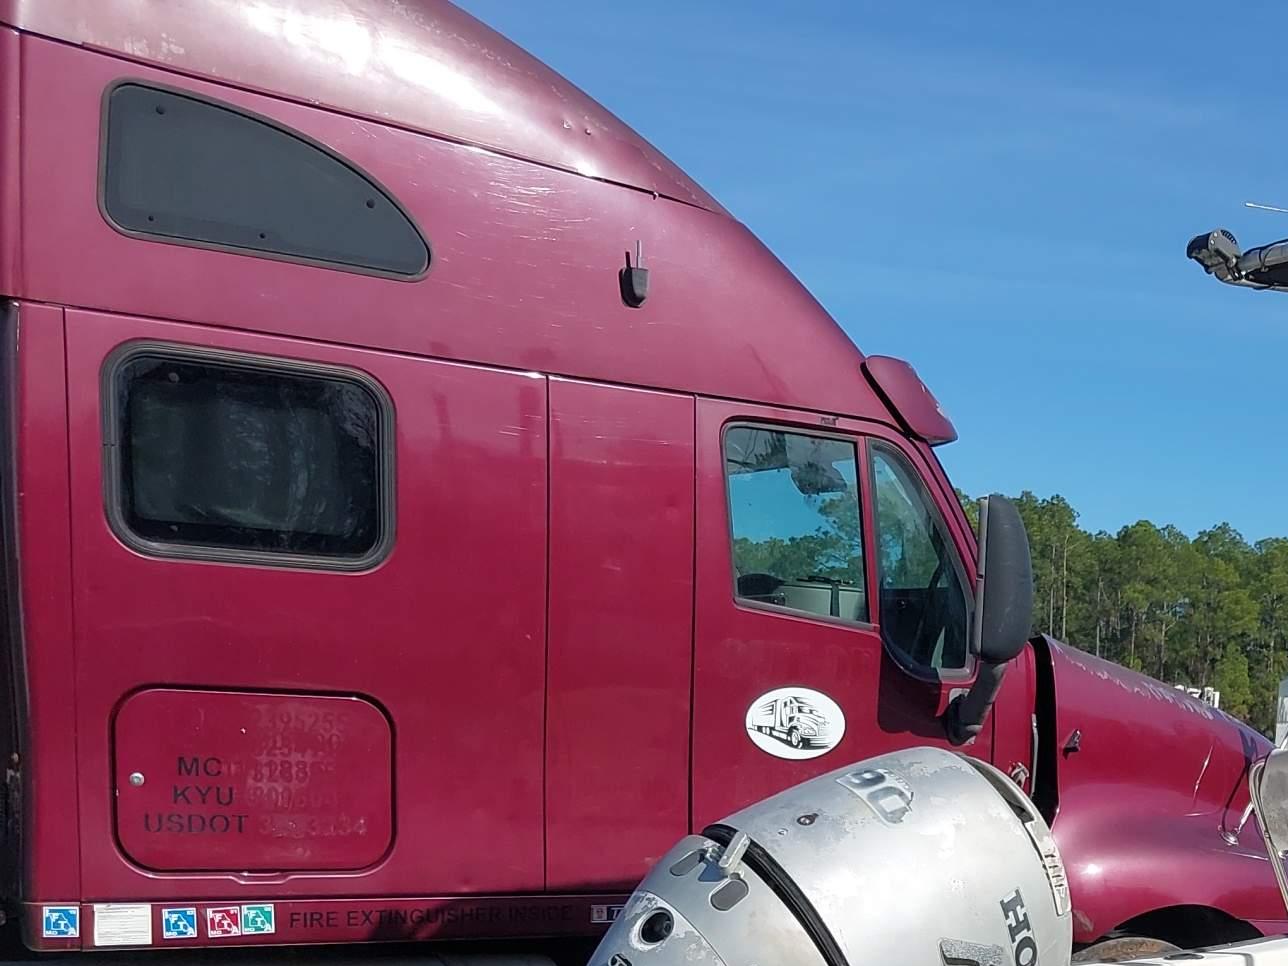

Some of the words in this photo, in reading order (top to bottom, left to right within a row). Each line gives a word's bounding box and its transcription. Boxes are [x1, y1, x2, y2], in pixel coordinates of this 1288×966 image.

[177, 756, 223, 777] MC
[172, 785, 234, 806] KYU
[143, 813, 249, 834] USDOT
[289, 911, 338, 929] FIRE
[346, 904, 505, 928] EXTINGUISHER
[507, 903, 574, 922] INSIDE
